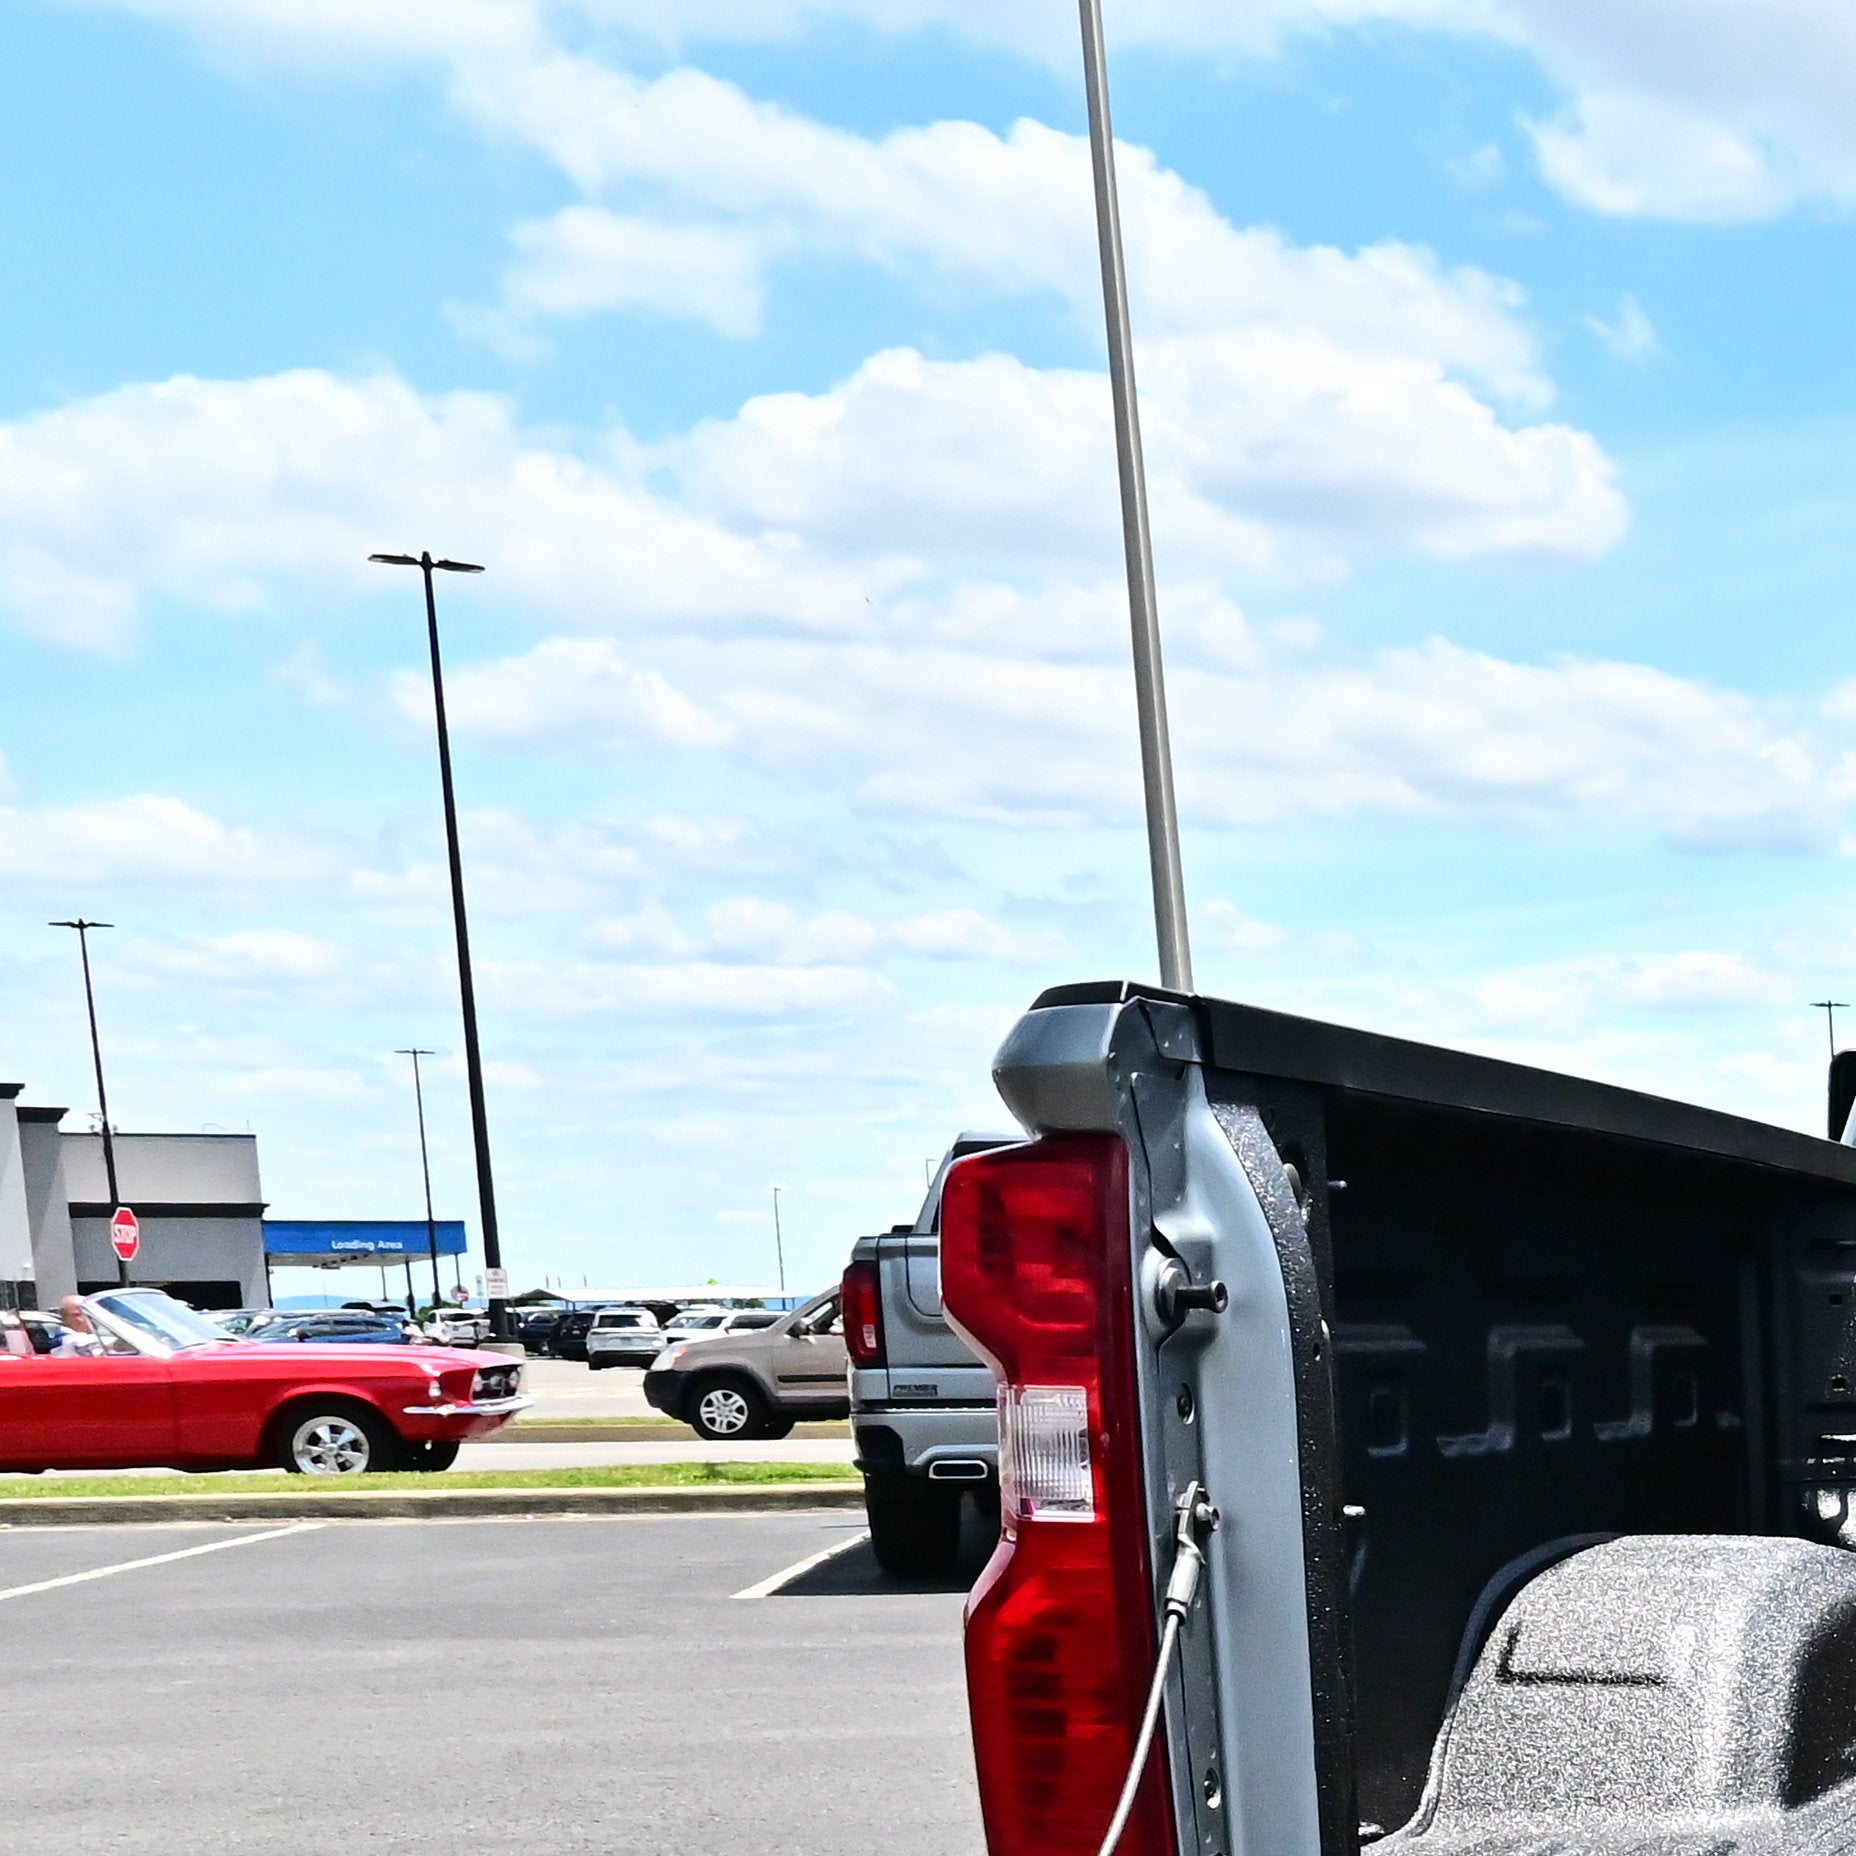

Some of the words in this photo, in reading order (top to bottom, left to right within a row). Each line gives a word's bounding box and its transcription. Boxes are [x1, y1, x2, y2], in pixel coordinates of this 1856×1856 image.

[114, 1224, 137, 1243] STOP
[331, 1240, 375, 1251] Loading
[377, 1240, 403, 1249] Area
